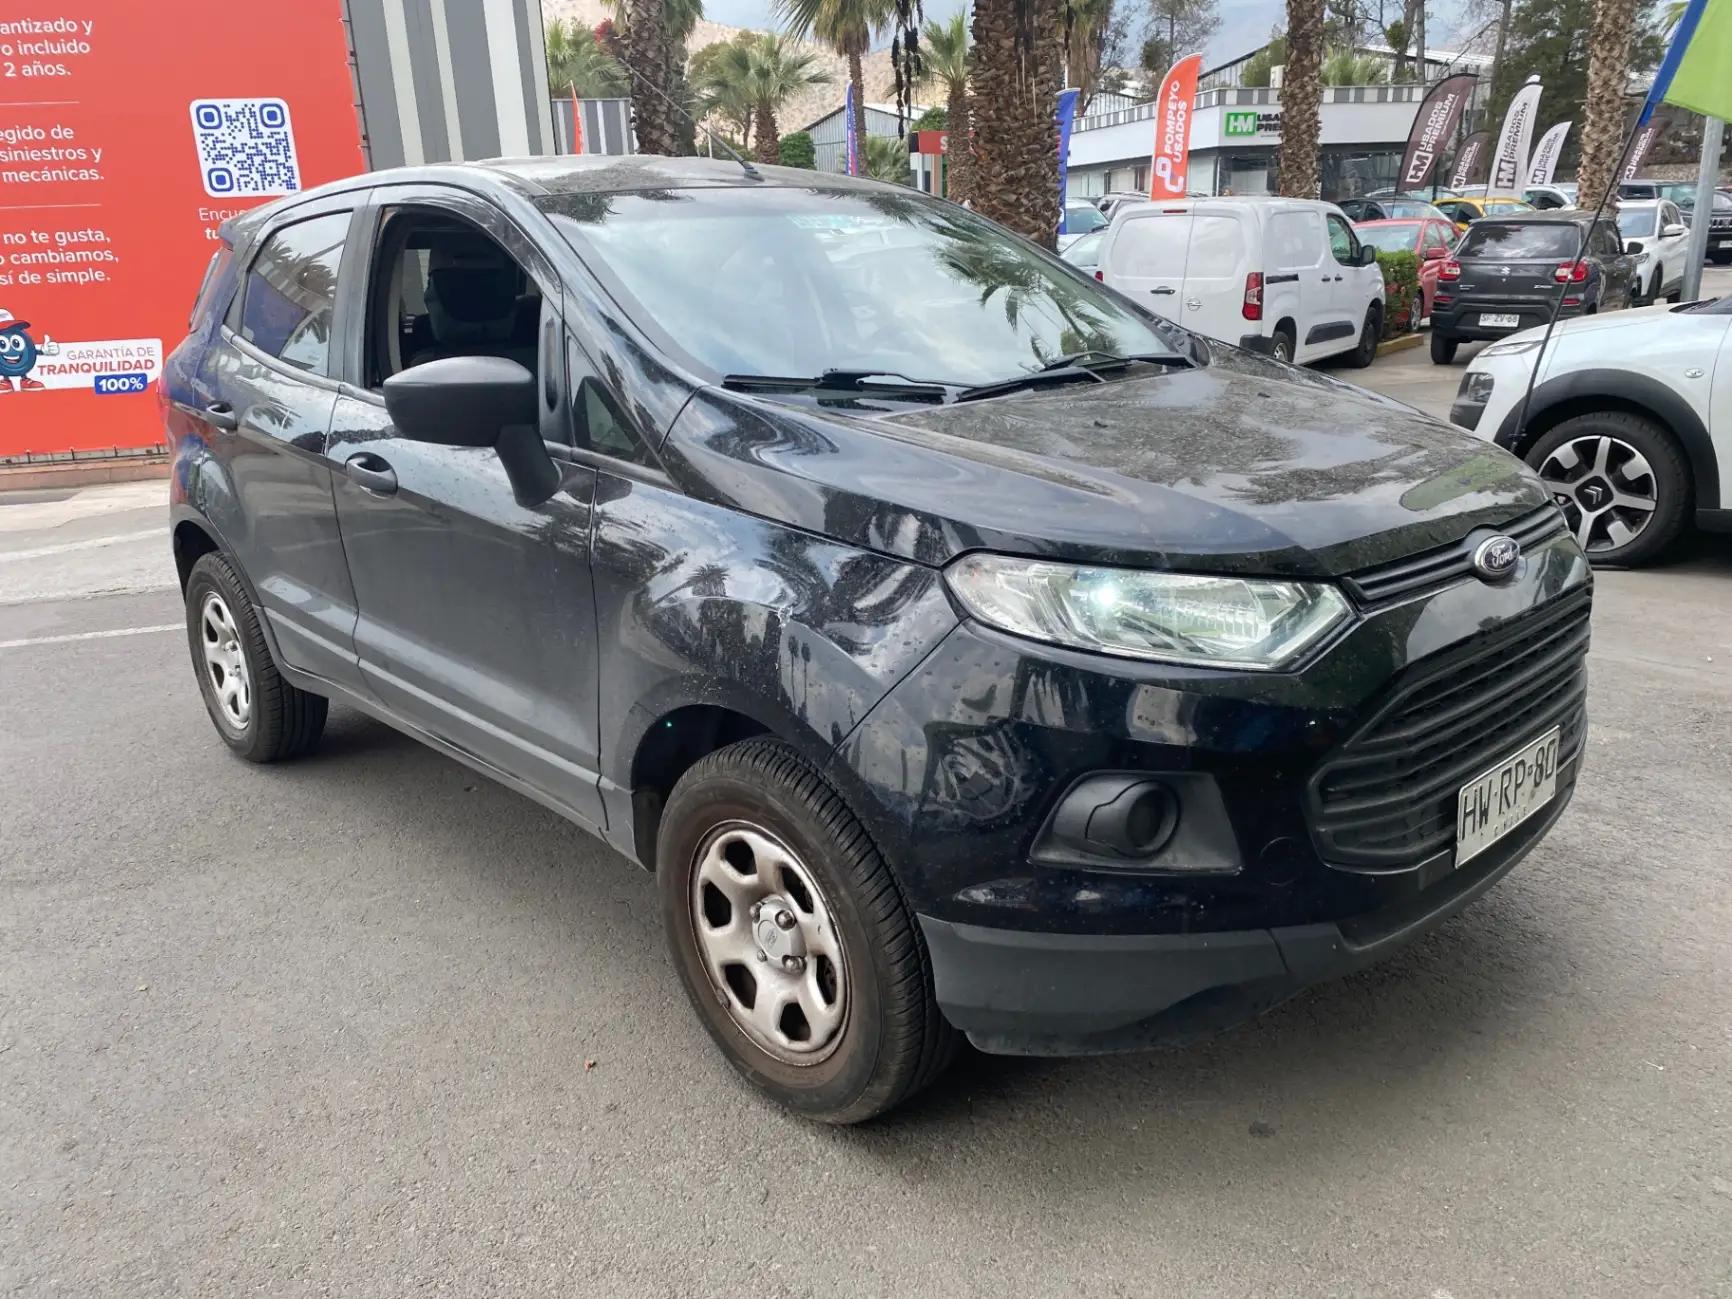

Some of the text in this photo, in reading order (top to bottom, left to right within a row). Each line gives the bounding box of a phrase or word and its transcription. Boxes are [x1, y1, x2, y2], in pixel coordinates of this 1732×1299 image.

[0, 17, 93, 36] antizado y
[17, 39, 91, 55] incluido
[4, 60, 72, 77] 2 años.
[1164, 80, 1181, 155] POMPEYO
[1227, 114, 1255, 134] HM
[1418, 101, 1444, 151] USADOS
[1426, 93, 1456, 152] PREMIUM
[51, 124, 74, 139] de
[1173, 100, 1188, 163] USADOS
[1503, 110, 1520, 159] USADOS
[1509, 102, 1528, 160] PREMIUM
[0, 146, 102, 163] siniestros y
[2, 166, 105, 183] mecánicas.
[1407, 152, 1432, 182] HM
[1496, 159, 1516, 188] HM
[3, 228, 111, 246] no te gusta,
[10, 248, 119, 265] cambiamos,
[19, 270, 41, 285] de
[47, 268, 112, 286] simple.
[66, 346, 155, 361] GARANTÍA DE
[38, 359, 155, 377] TRANQUILIDAD
[98, 376, 144, 392] 100%
[1491, 543, 1513, 568] Ford
